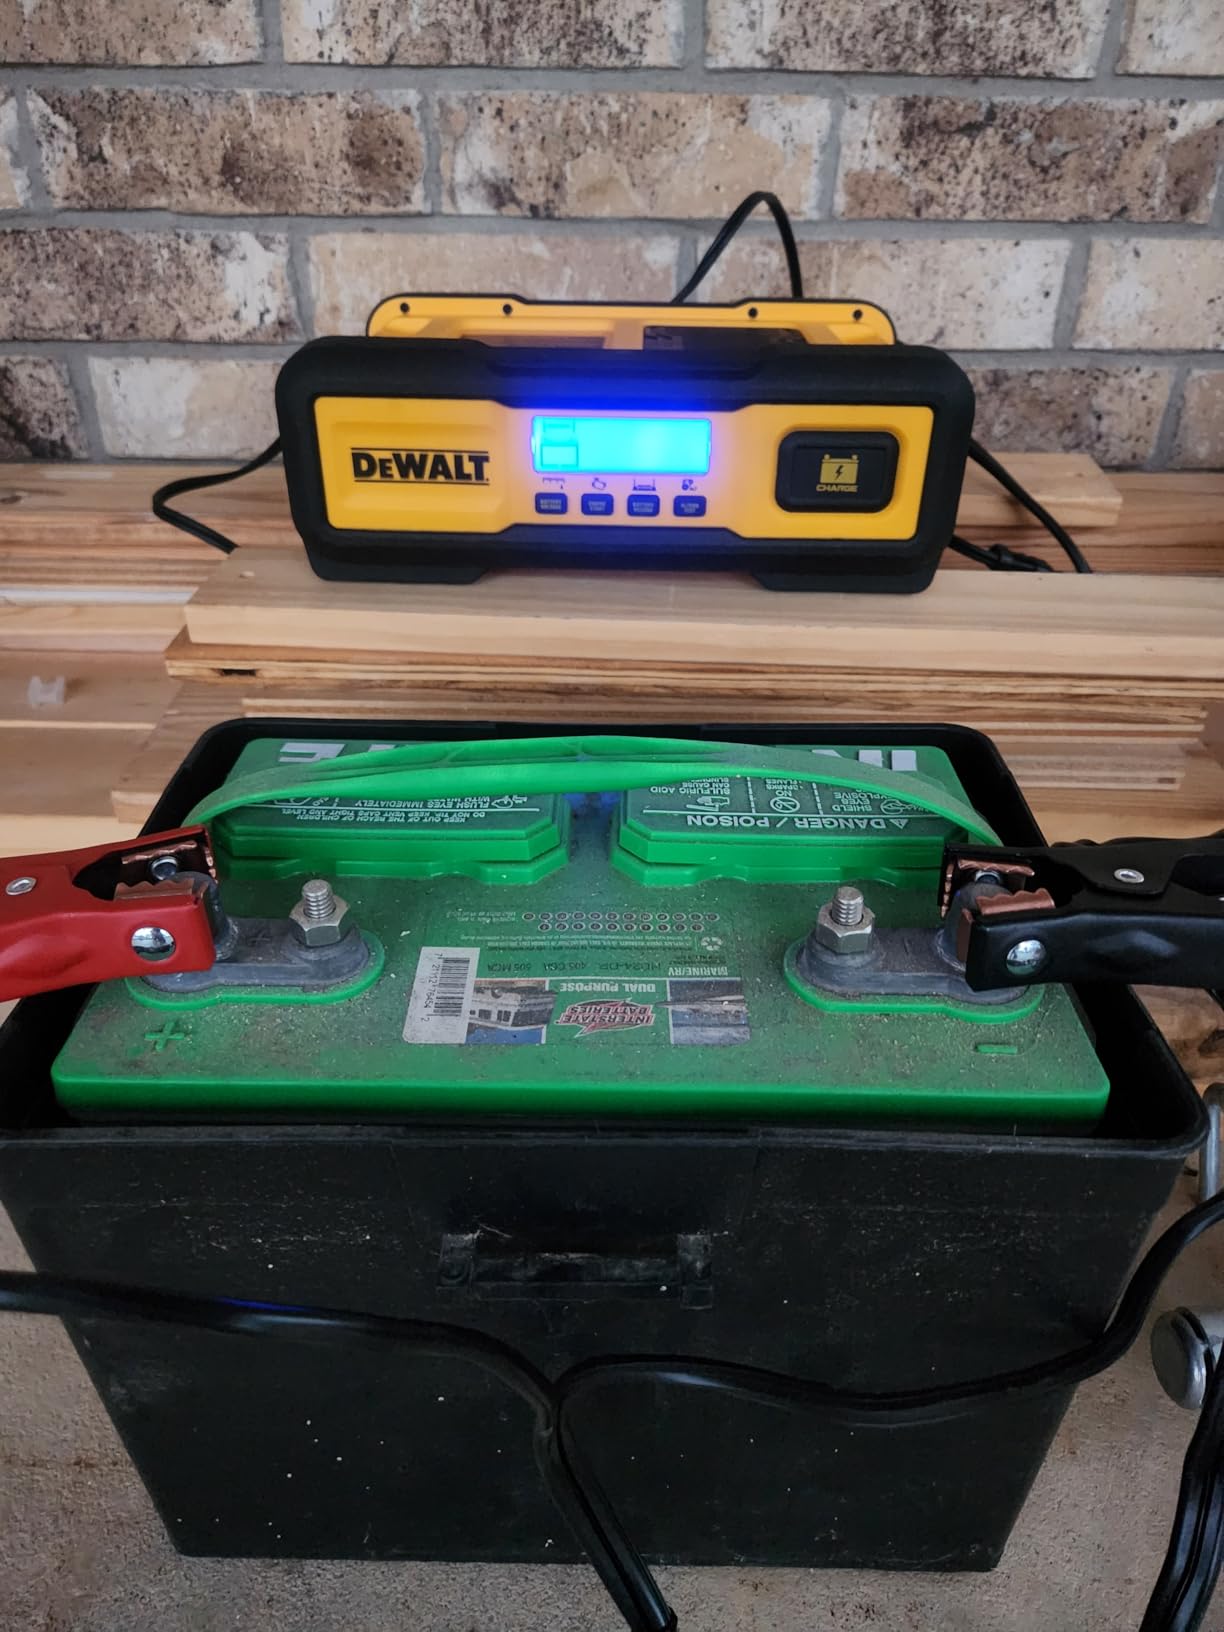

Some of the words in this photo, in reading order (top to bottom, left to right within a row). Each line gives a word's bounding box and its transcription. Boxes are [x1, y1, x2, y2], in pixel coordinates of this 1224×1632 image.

[816, 484, 858, 493] CHARGE
[355, 800, 424, 808] IMMEDIATELY
[686, 815, 770, 827] POISON
[794, 817, 886, 829] DANGER
[668, 966, 728, 976] MARINE/RV
[560, 982, 618, 992] PURPOSE
[622, 983, 656, 992] DUAL
[569, 1006, 648, 1014] BATTERIES
[563, 1015, 650, 1024] INTERSTATE
